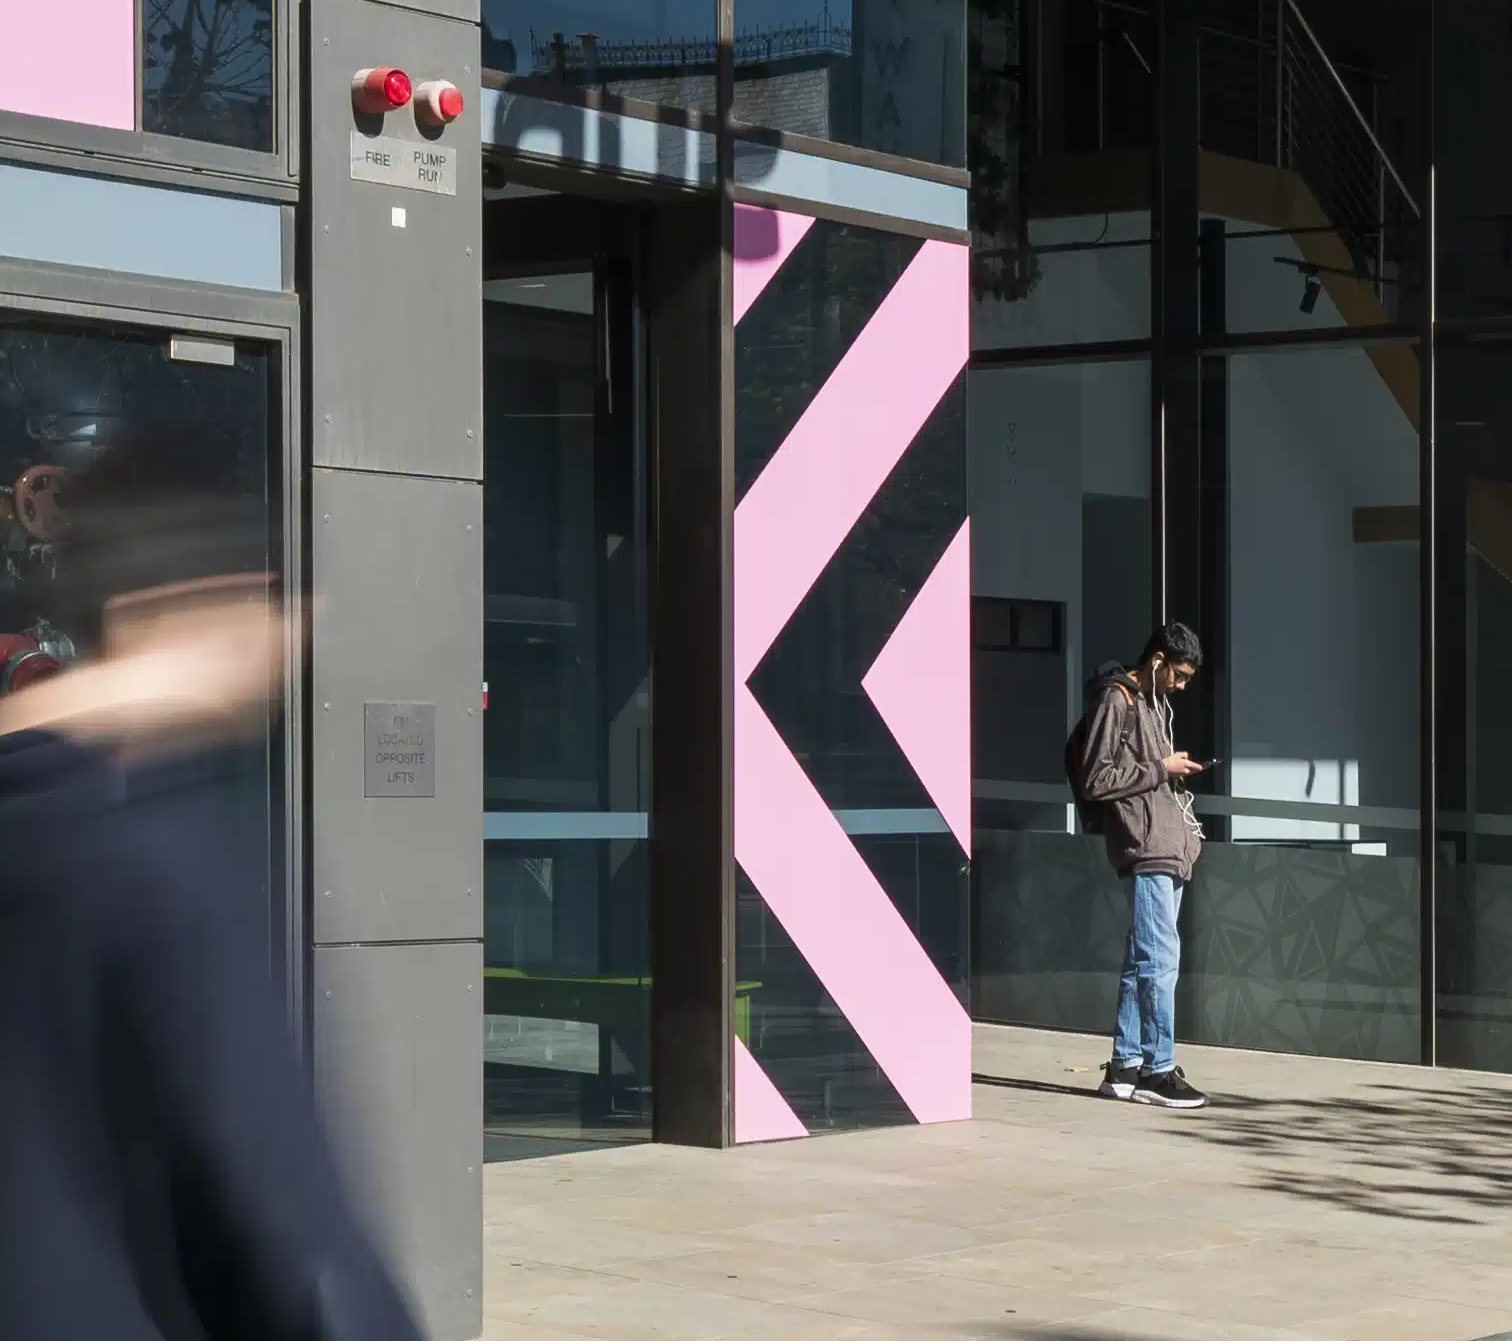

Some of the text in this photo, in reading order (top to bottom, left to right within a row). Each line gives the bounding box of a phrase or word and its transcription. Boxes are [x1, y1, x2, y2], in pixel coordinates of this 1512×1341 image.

[365, 151, 391, 167] FIRE
[413, 151, 447, 167] PUMP
[418, 168, 443, 182] RUN
[376, 752, 426, 766] OPPOSITE
